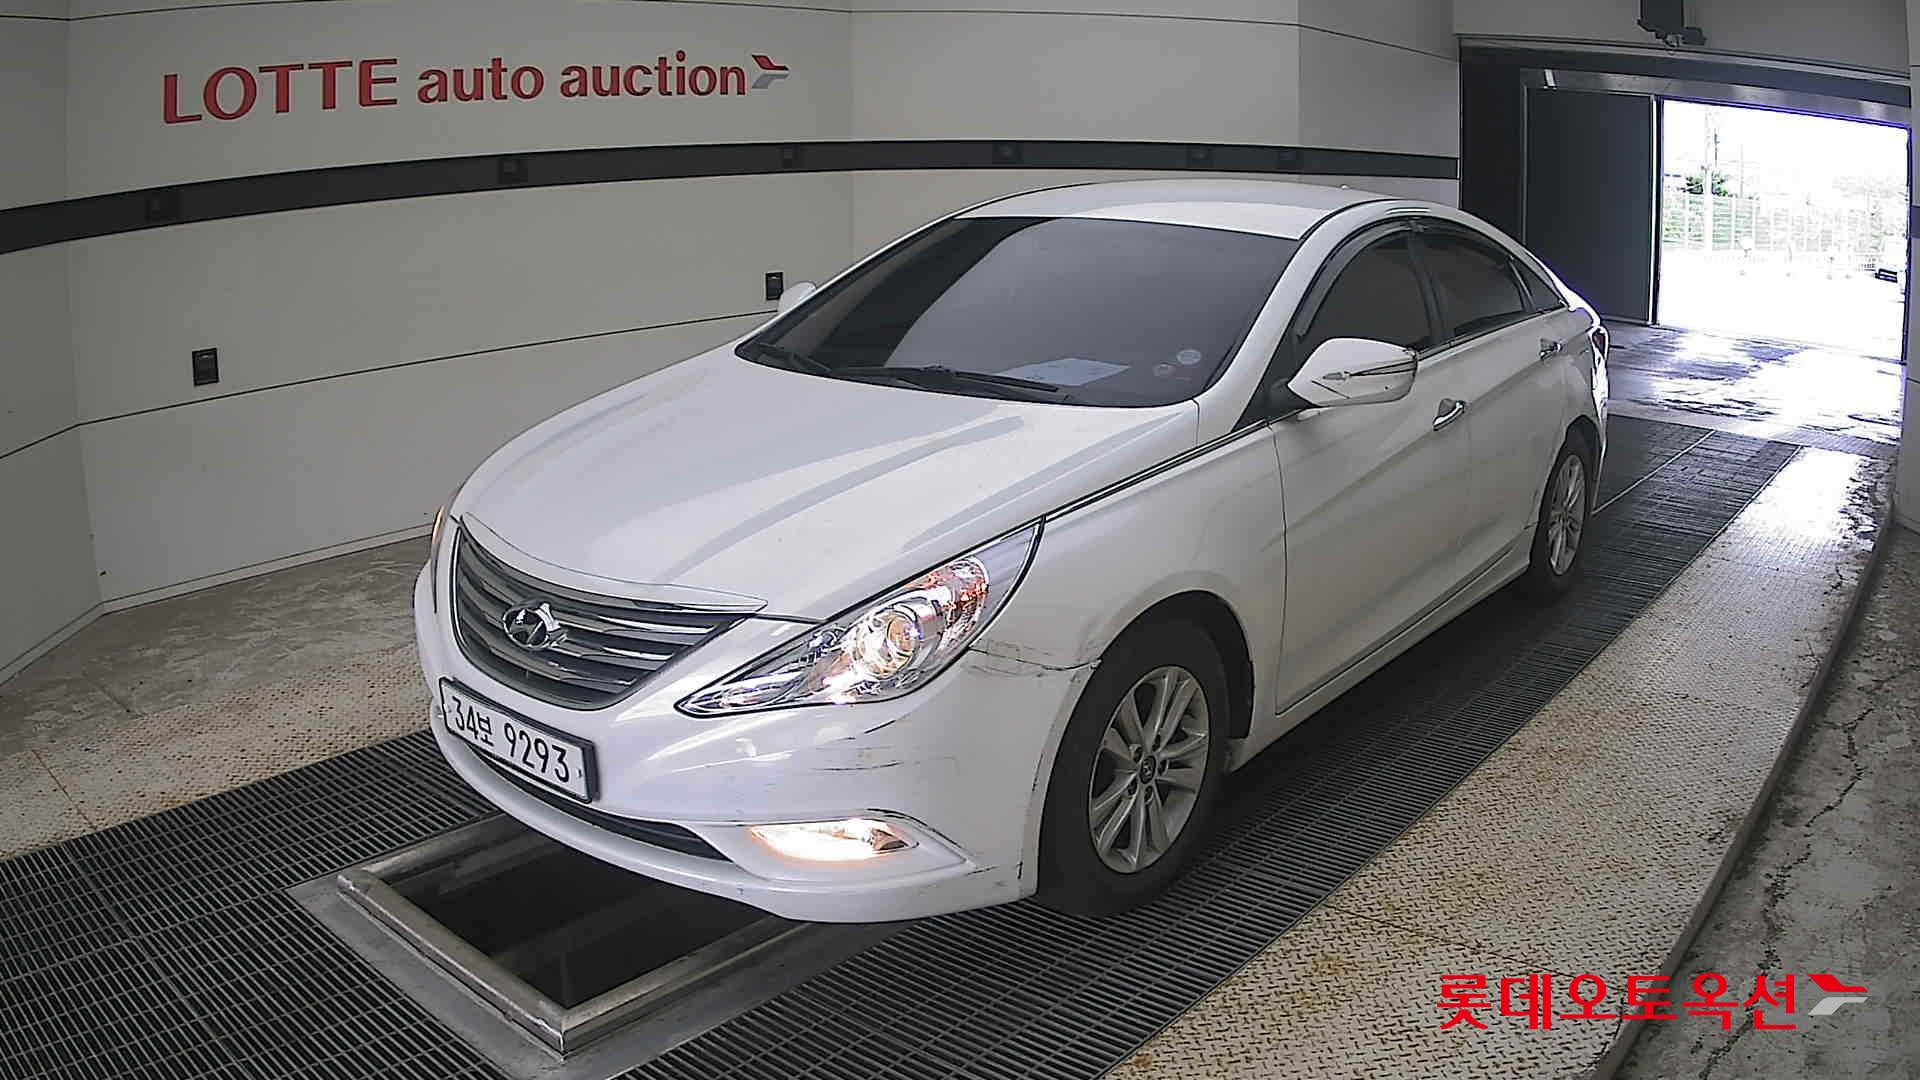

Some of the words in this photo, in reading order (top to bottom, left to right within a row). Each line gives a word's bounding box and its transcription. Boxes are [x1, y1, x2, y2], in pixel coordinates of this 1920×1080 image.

[162, 57, 398, 125] LOTTE
[416, 56, 545, 105] auto
[559, 49, 748, 98] auction
[452, 695, 495, 747] 34보
[504, 722, 570, 783] 9293
